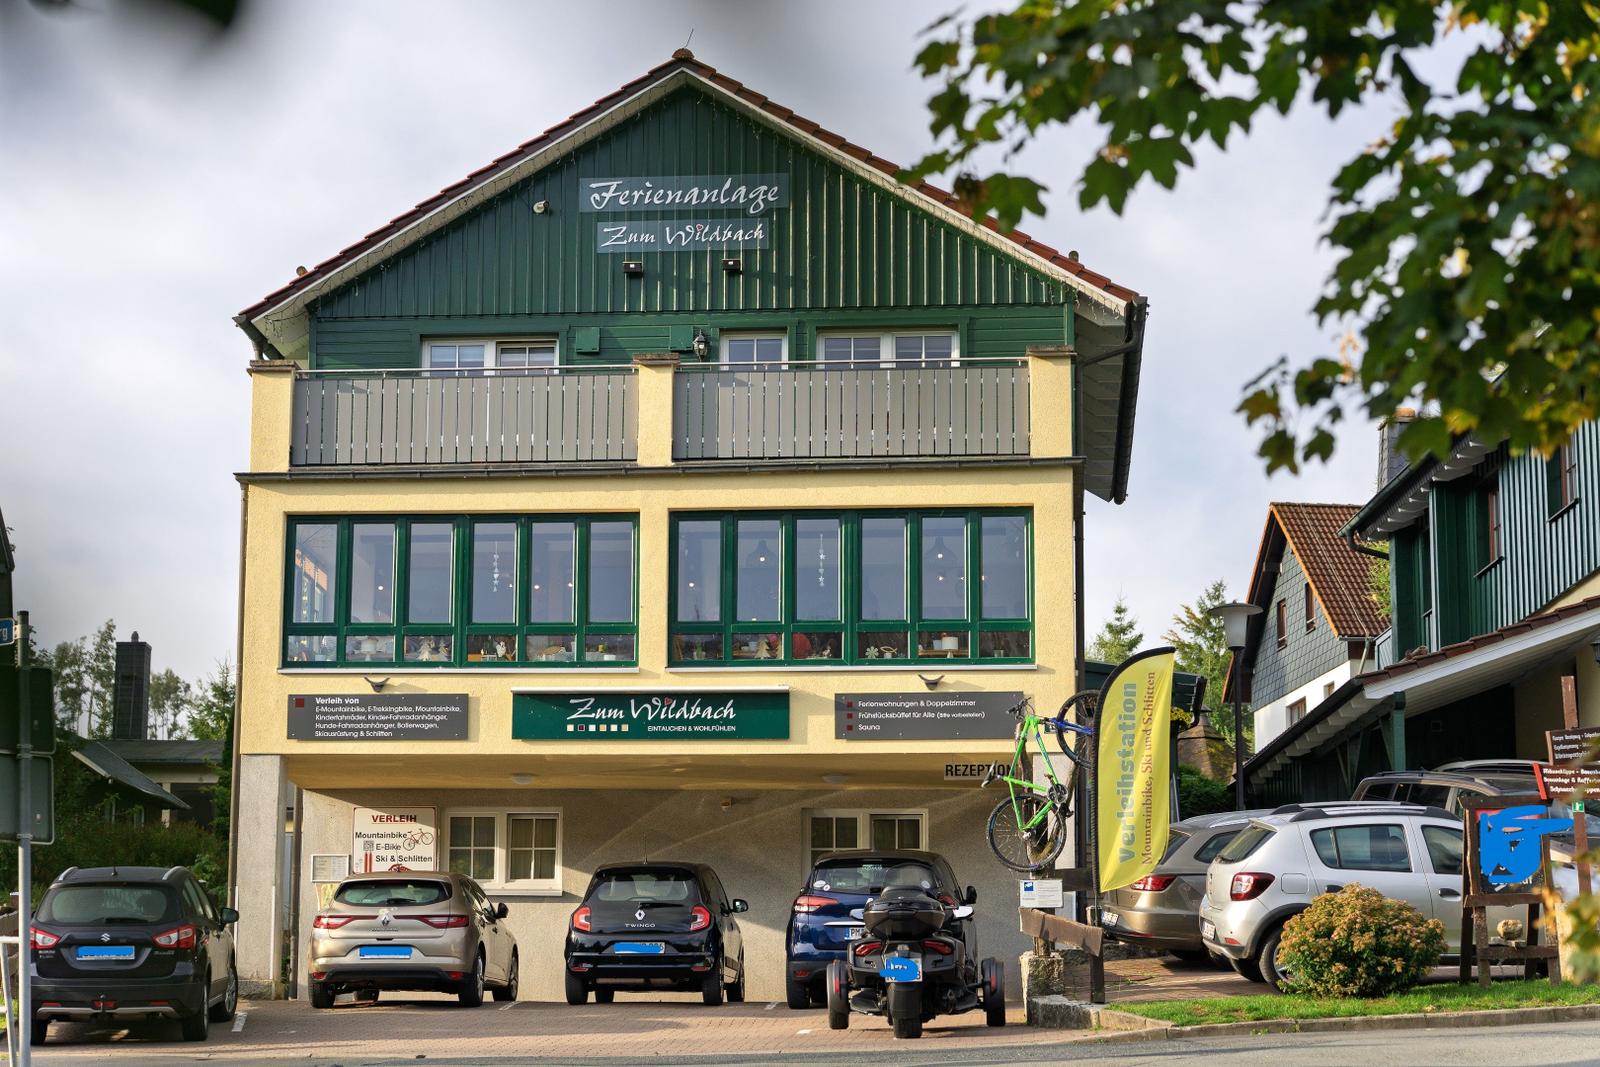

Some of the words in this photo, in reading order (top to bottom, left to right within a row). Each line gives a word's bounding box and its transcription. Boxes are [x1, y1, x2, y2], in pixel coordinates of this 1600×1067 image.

[588, 177, 779, 214] Ferienanlage
[600, 225, 656, 247] Zum
[665, 223, 765, 247] Wildbach
[566, 697, 625, 720] Zum
[630, 696, 736, 720] Wildbach
[858, 700, 919, 708] Ferienwohnungen
[1142, 672, 1156, 725] Schlitten
[693, 724, 736, 732] WOHLFÜHLEN
[858, 723, 881, 731] Sauna
[1142, 728, 1153, 751] und
[1116, 683, 1136, 864] Verleihstation
[1141, 753, 1153, 774] Ski
[371, 814, 417, 823] VERLEIH
[1142, 776, 1153, 865] Mountainbike,
[355, 831, 408, 839] Mountainbike
[375, 843, 401, 851] E-Bike
[398, 854, 433, 862] Schlitten
